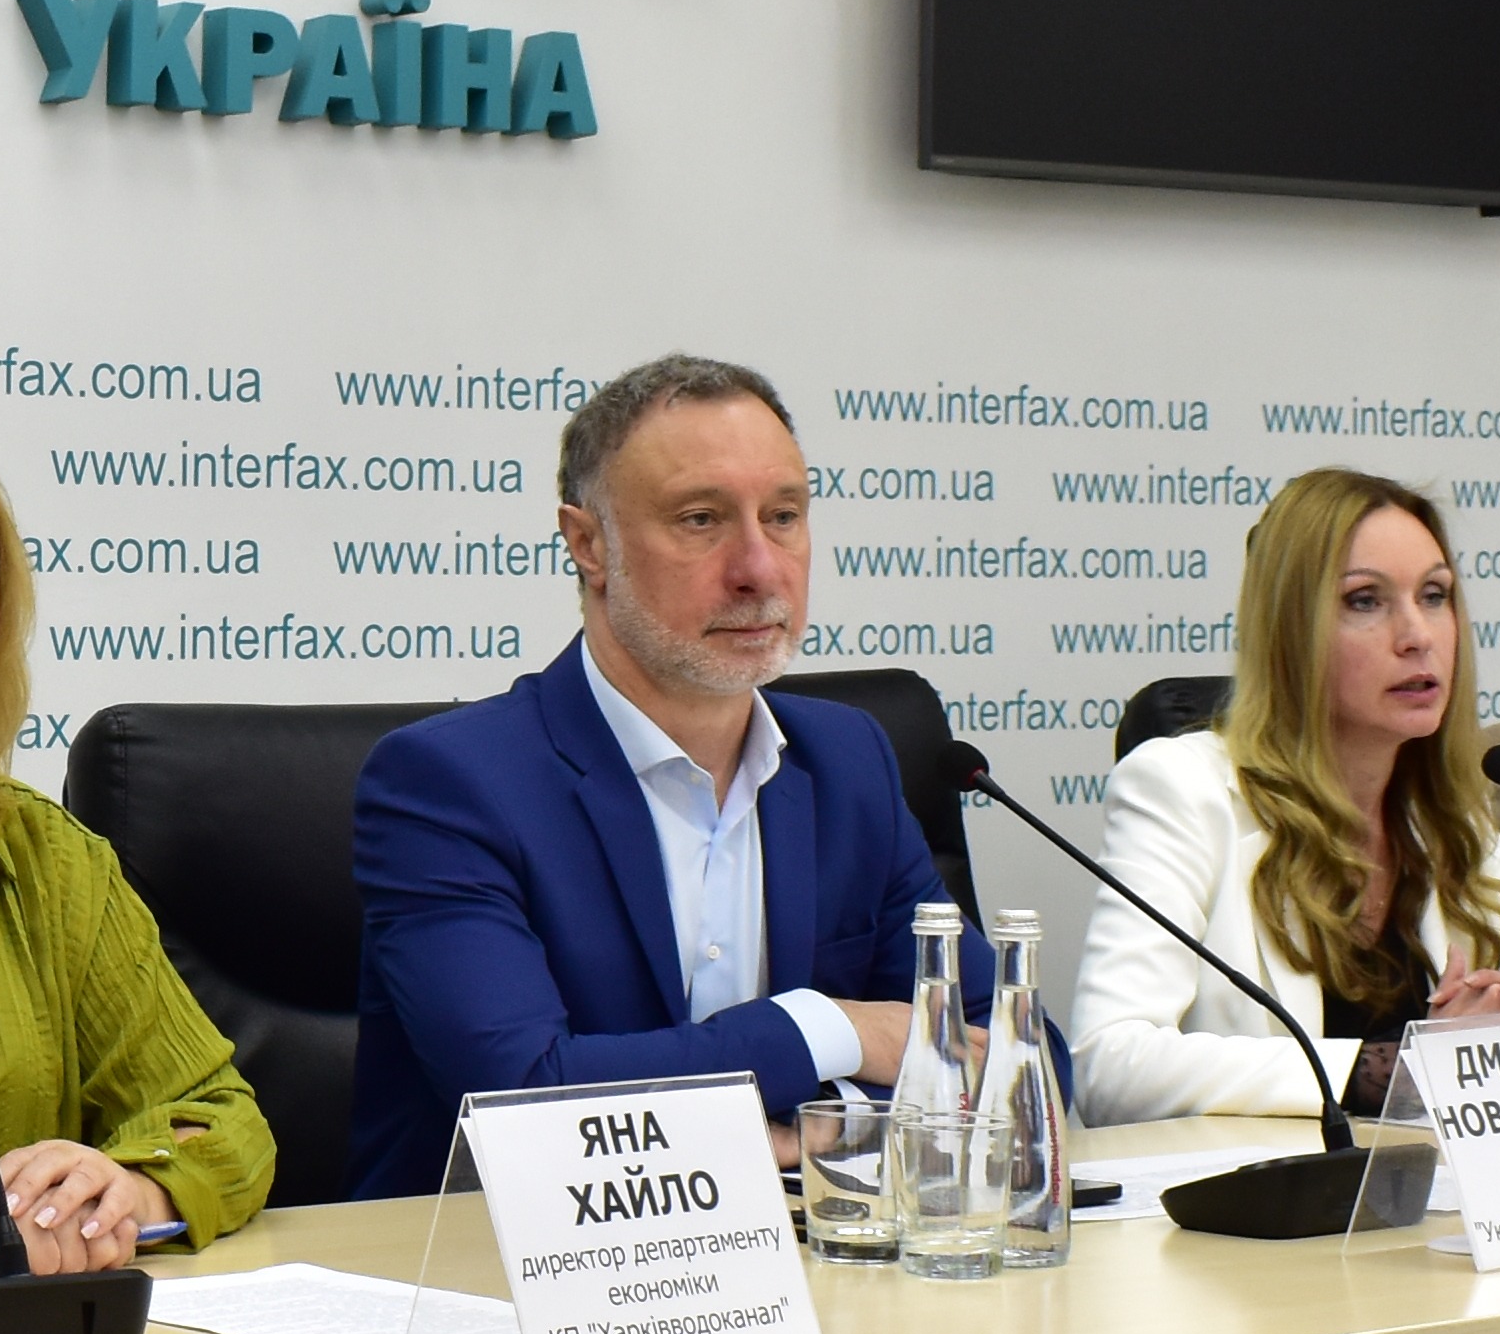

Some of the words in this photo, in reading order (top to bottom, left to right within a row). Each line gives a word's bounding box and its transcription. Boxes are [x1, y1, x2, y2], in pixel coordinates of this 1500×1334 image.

[836, 384, 1208, 431] www.interfax.com.ua
[51, 440, 523, 493] www.interfax.com.ua
[835, 536, 1208, 579] www.interfax.com.ua
[50, 613, 521, 660] www.interfax.com.ua
[579, 1110, 670, 1158] ЯНА
[566, 1164, 720, 1226] ХАЙЛО
[521, 1244, 626, 1282] директор
[633, 1225, 781, 1268] департаменту
[607, 1272, 720, 1306] економіки
